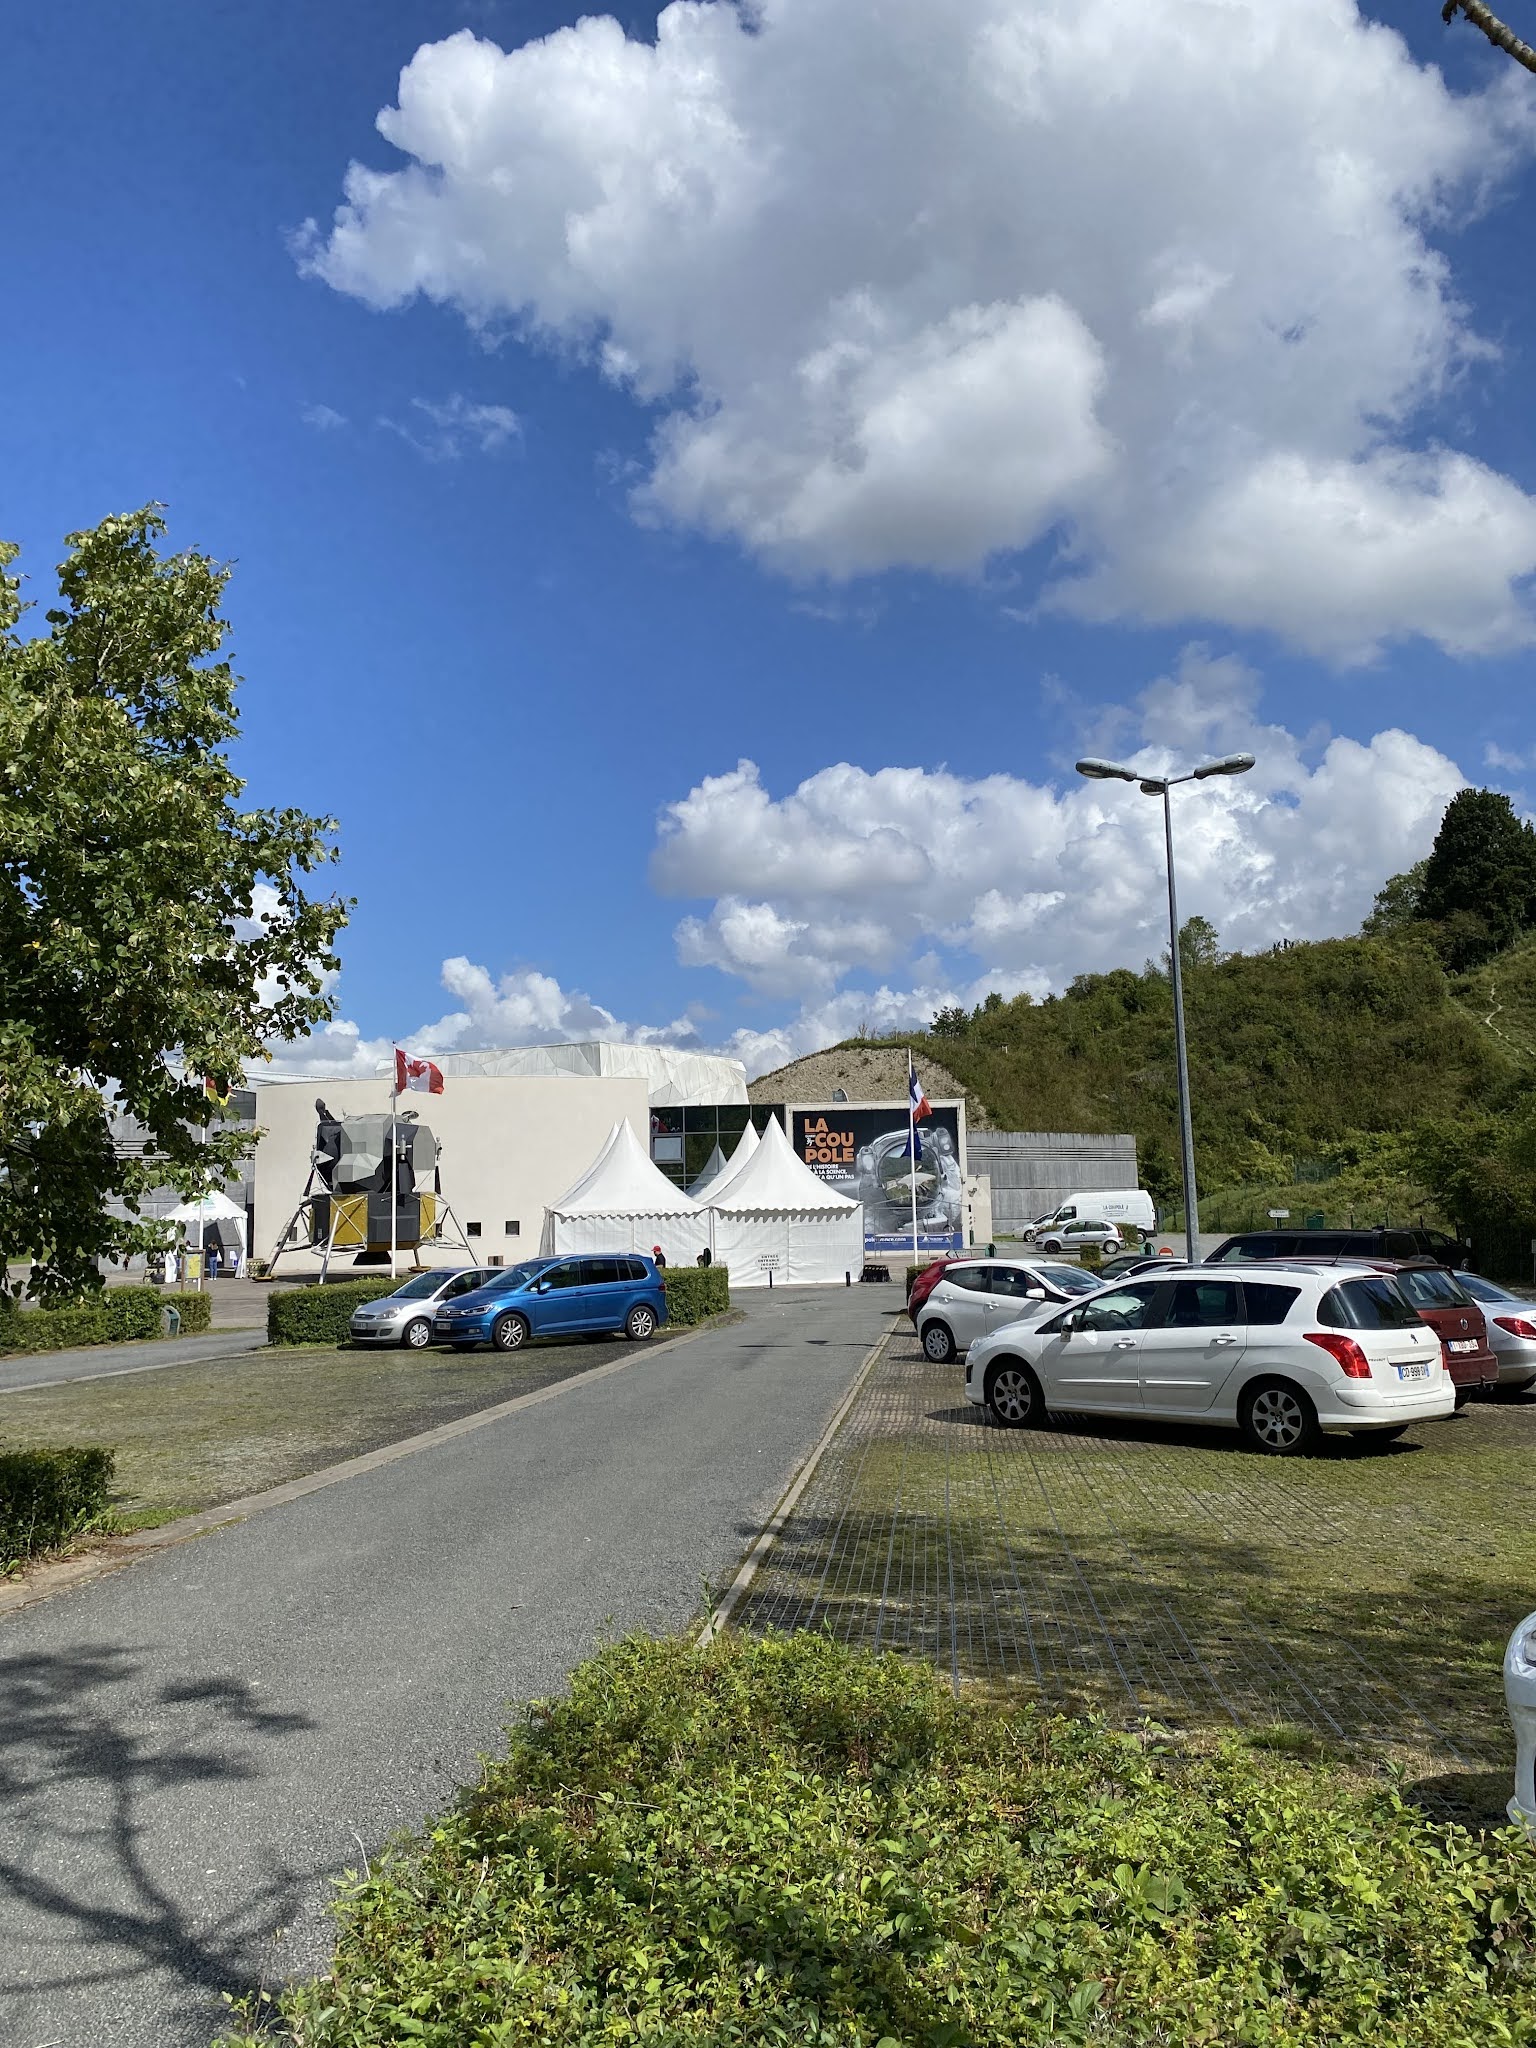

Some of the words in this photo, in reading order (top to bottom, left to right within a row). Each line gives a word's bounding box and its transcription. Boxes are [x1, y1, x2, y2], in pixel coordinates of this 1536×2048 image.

[804, 1117, 829, 1133] LA
[815, 1132, 854, 1147] COU
[805, 1147, 855, 1163] POLE
